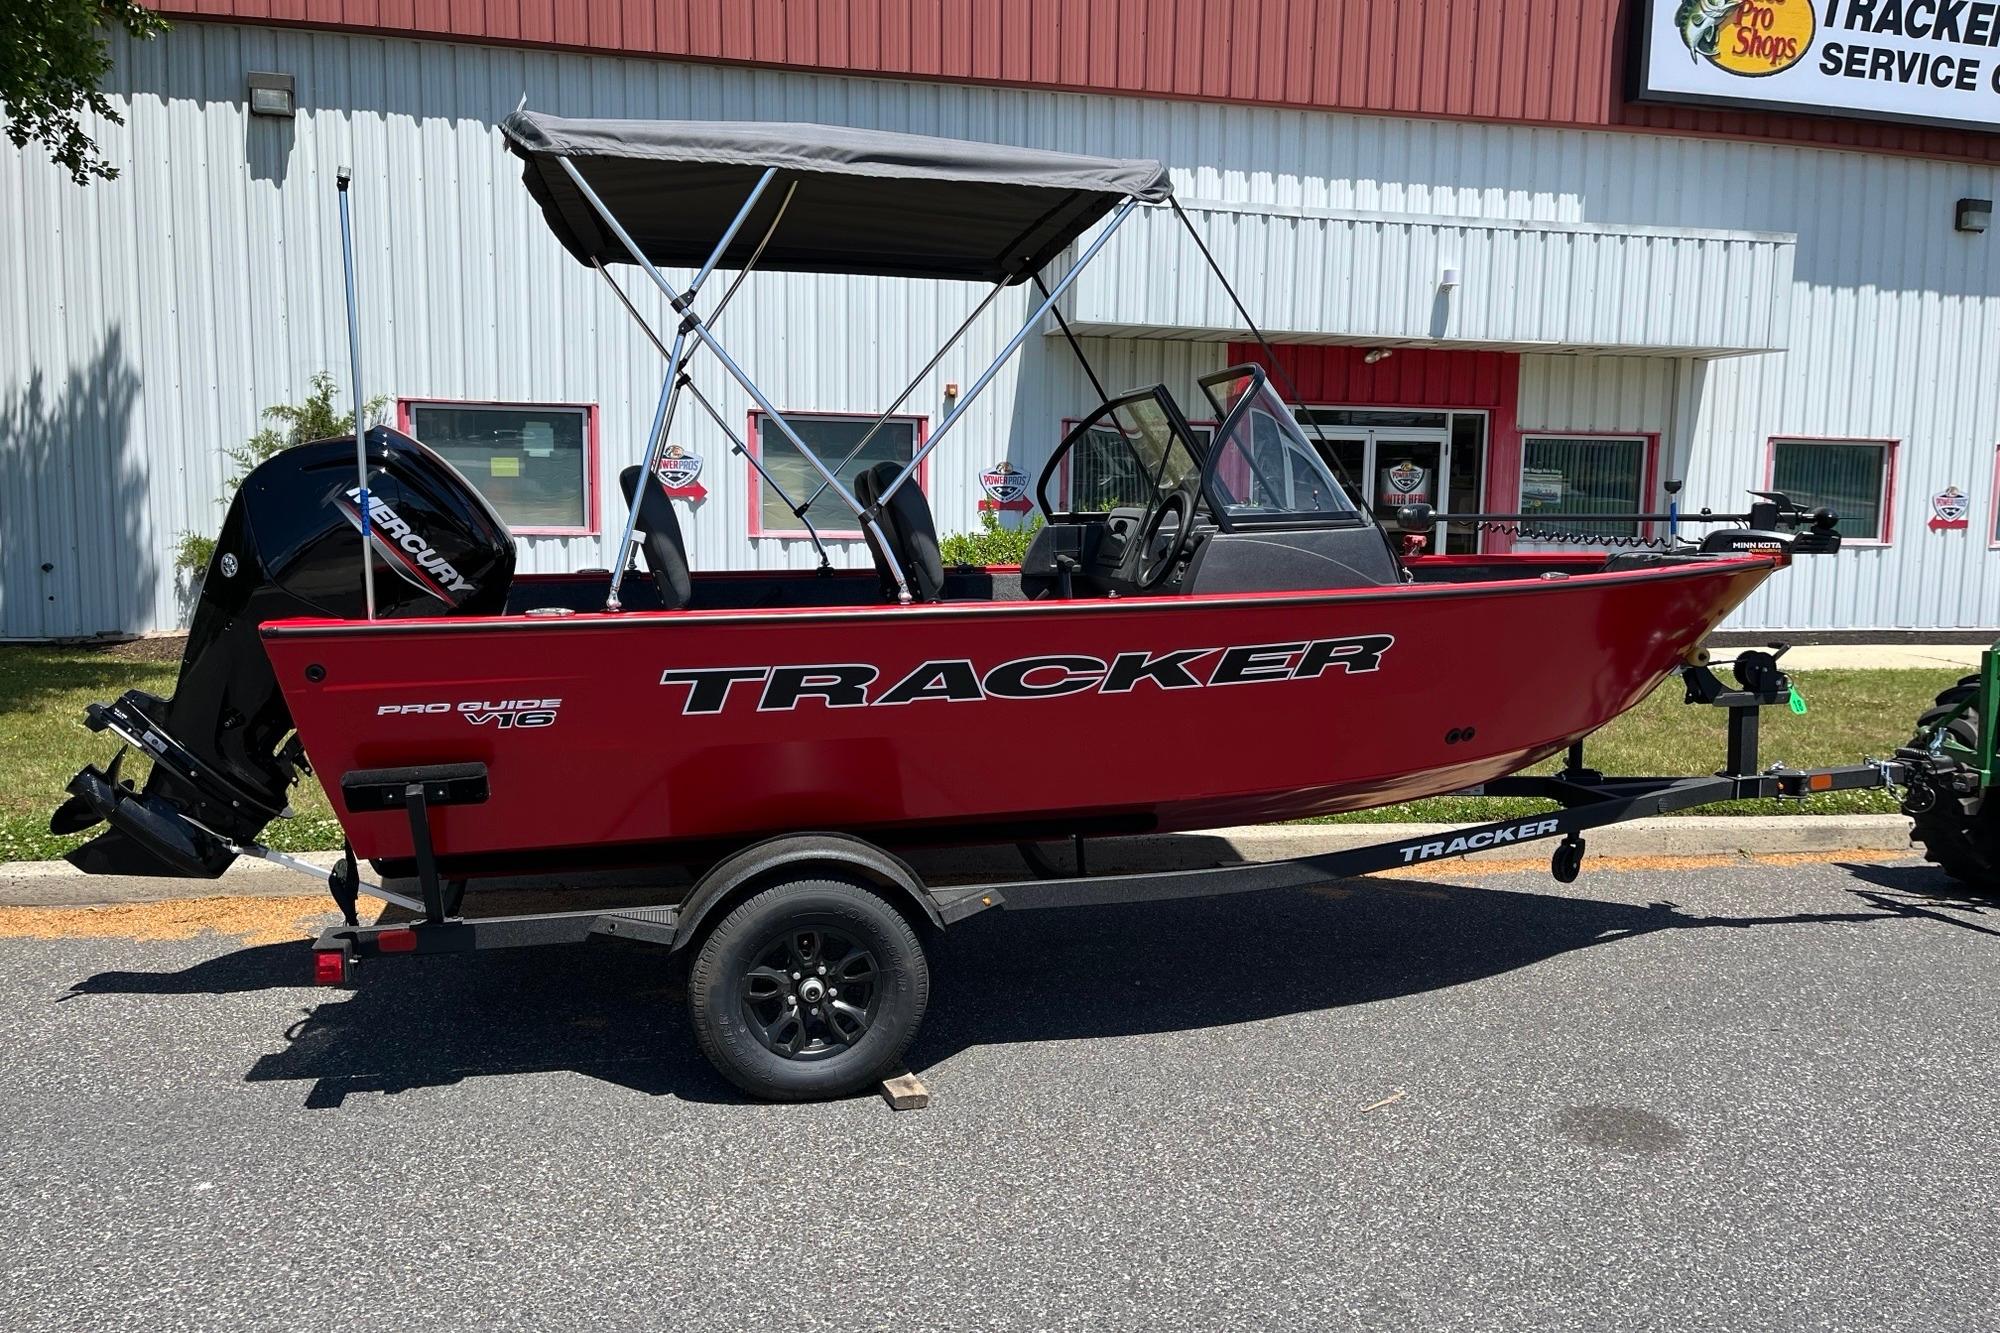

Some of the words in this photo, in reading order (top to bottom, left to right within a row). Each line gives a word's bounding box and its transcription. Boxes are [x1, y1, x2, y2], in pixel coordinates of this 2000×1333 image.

[1734, 0, 1774, 30] Pro
[1732, 26, 1797, 67] Shops
[1818, 41, 1981, 92] SERVICE
[345, 486, 476, 592] MERCURY
[1732, 541, 1757, 549] MINN
[1758, 541, 1782, 549] KOTA
[660, 633, 1396, 715] TRACKER
[376, 702, 451, 716] PRO
[456, 698, 562, 713] GUIDE
[463, 710, 557, 730] V16
[1399, 818, 1560, 863] TRACKER
